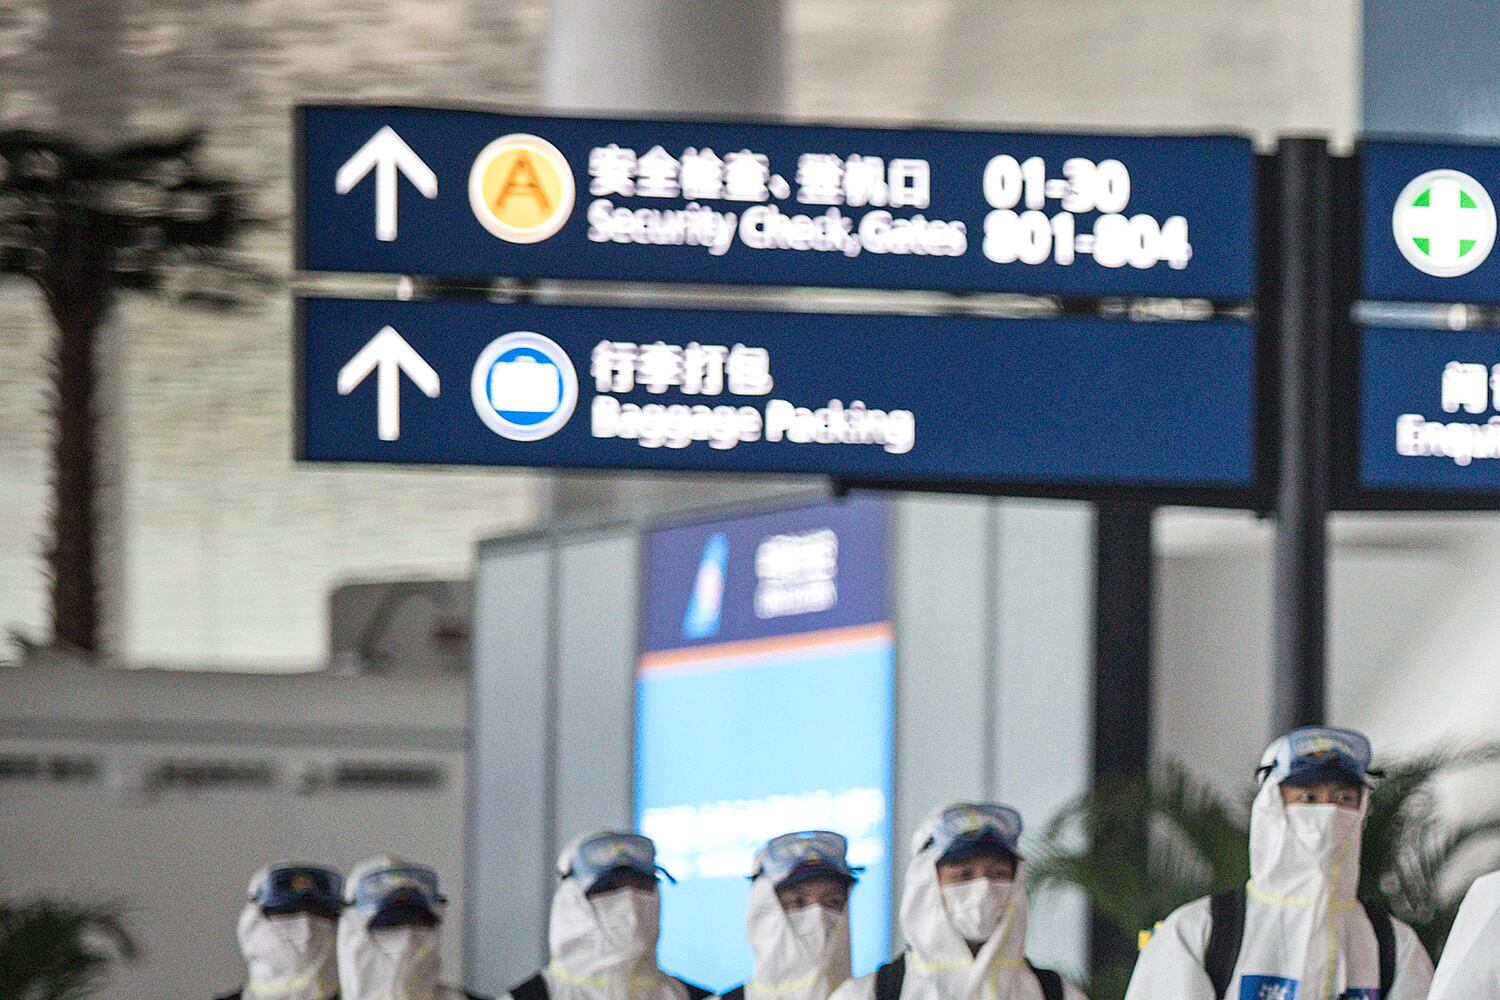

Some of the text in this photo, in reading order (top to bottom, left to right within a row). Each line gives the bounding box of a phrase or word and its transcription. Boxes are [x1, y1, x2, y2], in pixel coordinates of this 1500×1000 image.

[493, 150, 551, 213] A
[983, 154, 1131, 214] 01-30
[588, 199, 737, 256] Security
[858, 210, 968, 257] Gates
[590, 340, 774, 396] 行李打包
[592, 395, 915, 454] Baggage Packing
